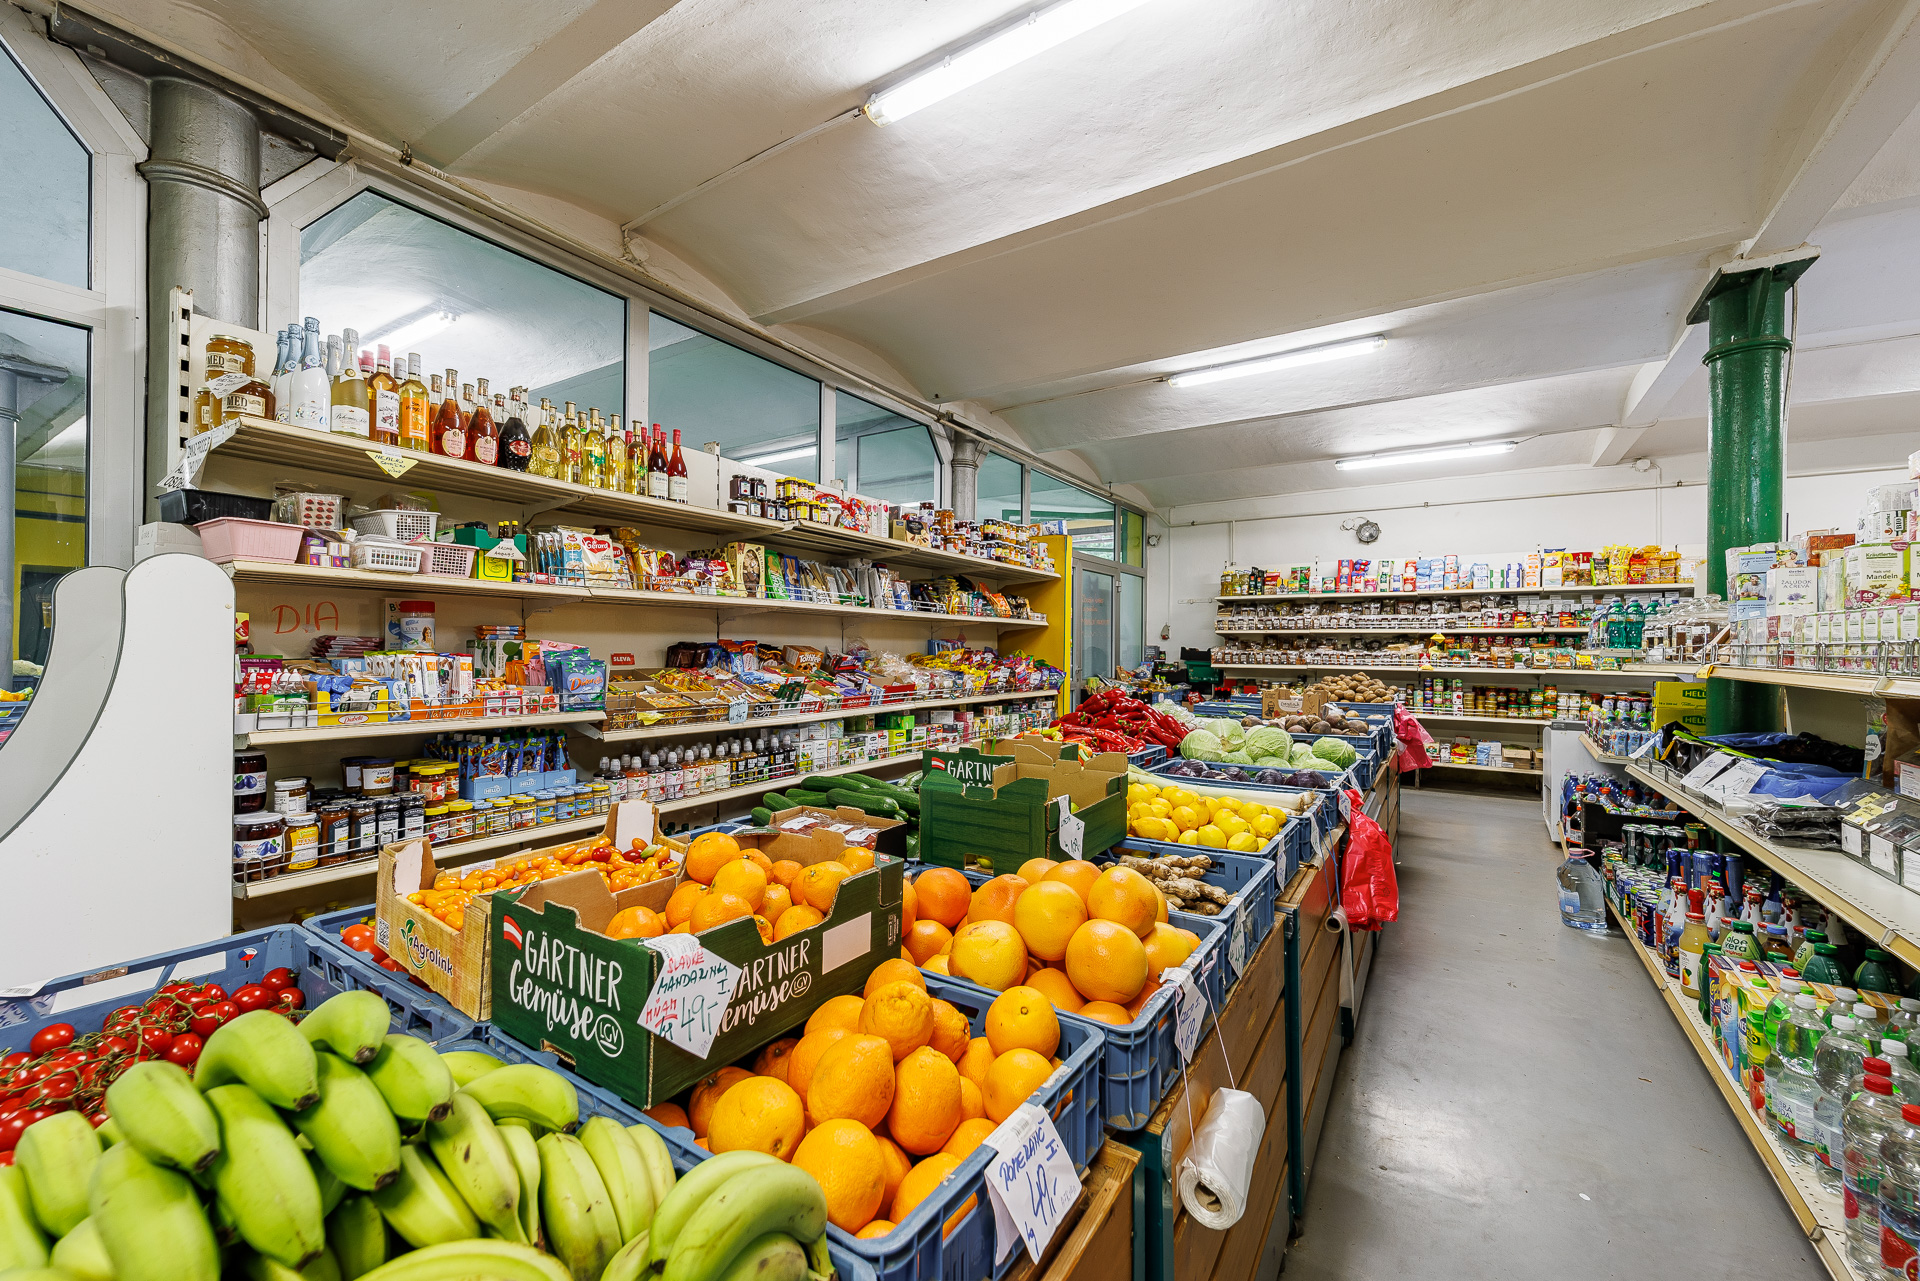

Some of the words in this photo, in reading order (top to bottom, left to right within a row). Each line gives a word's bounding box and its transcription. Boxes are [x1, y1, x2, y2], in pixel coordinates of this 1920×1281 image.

[207, 354, 225, 366] MED
[226, 395, 248, 407] MED
[271, 601, 340, 634] DIA
[947, 759, 1007, 781] GÄRTN
[1725, 942, 1747, 953] vera
[1727, 936, 1748, 946] aloe
[412, 935, 454, 977] Agrolink
[728, 938, 812, 1002] ÄRTNER
[524, 930, 623, 1011] GÄRTNER
[509, 958, 595, 1043] Gemüse
[715, 977, 792, 1037] emüse
[599, 1021, 619, 1044] LGV
